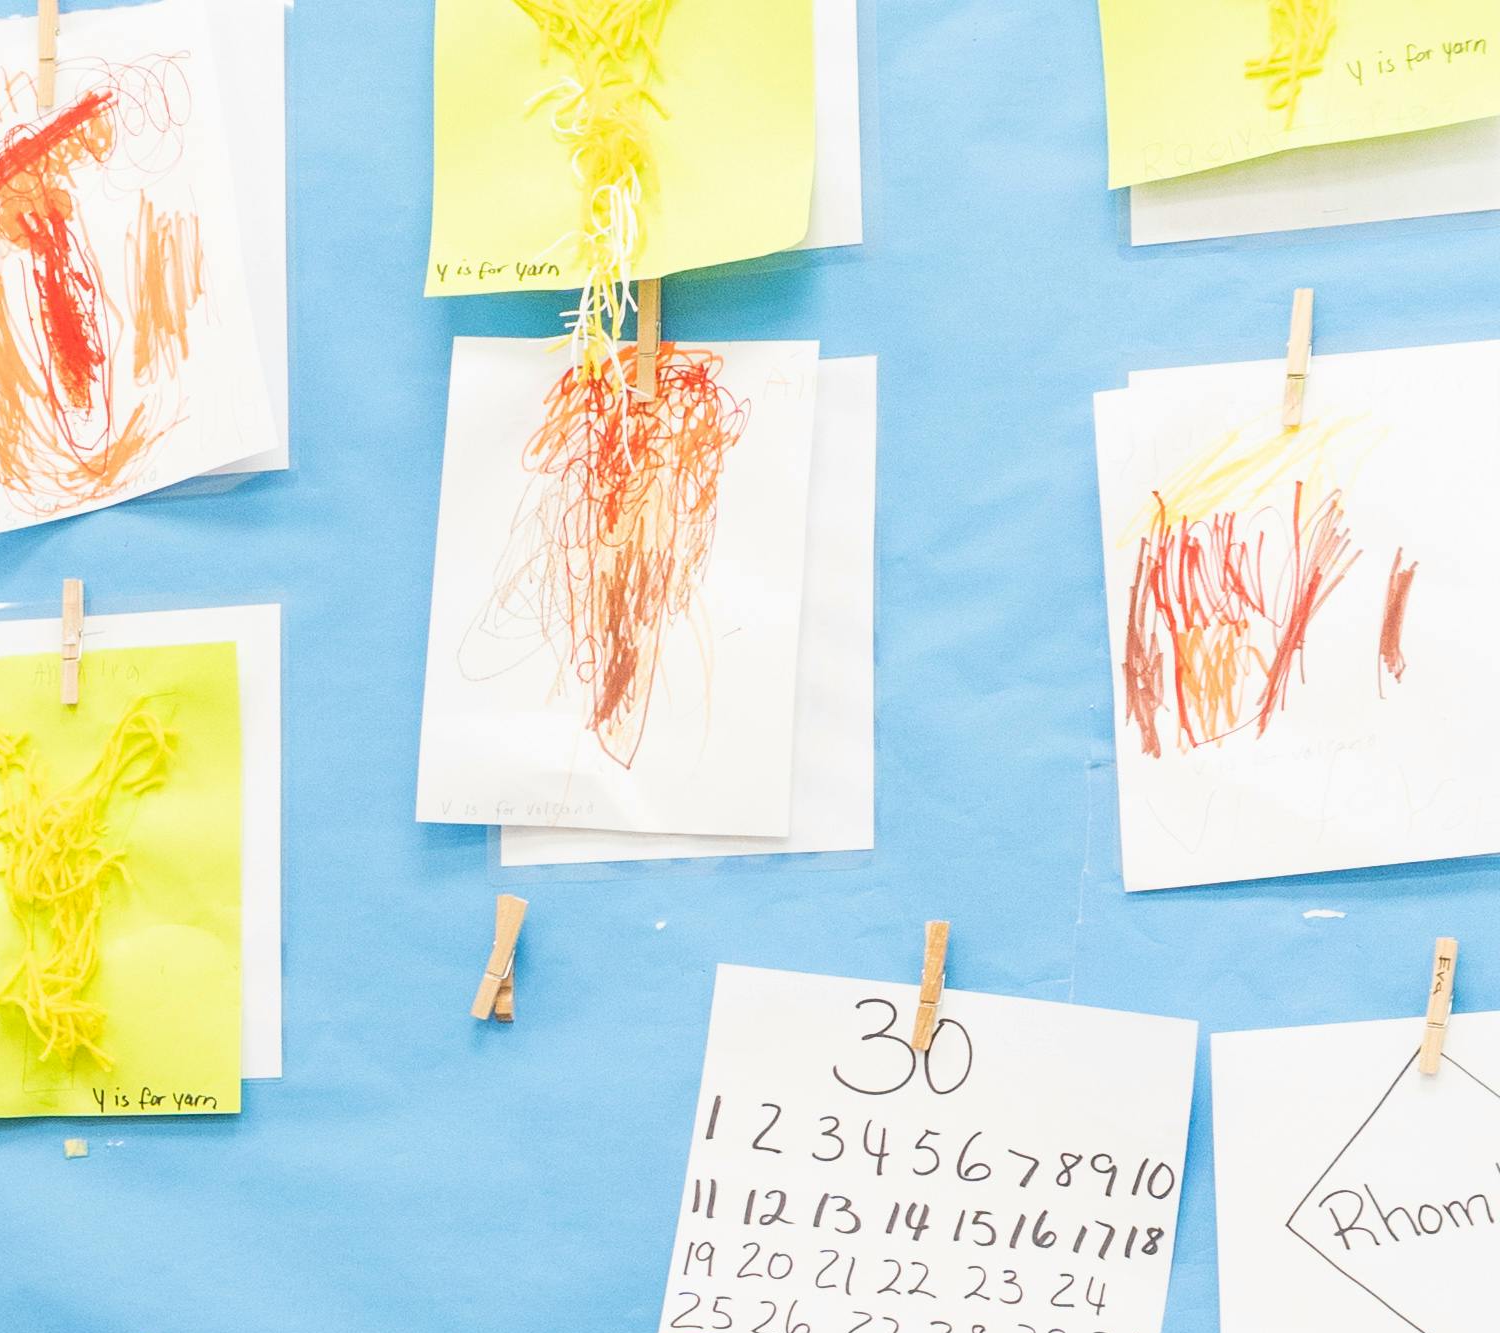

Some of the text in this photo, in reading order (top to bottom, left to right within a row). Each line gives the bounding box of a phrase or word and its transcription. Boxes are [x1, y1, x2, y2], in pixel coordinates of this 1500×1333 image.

[833, 999, 972, 1094] 30
[115, 1087, 129, 1107] is
[138, 1087, 166, 1110] for
[173, 1093, 217, 1110] yarn
[1319, 1163, 1500, 1250] Rhom
[670, 1292, 732, 1329] 25
